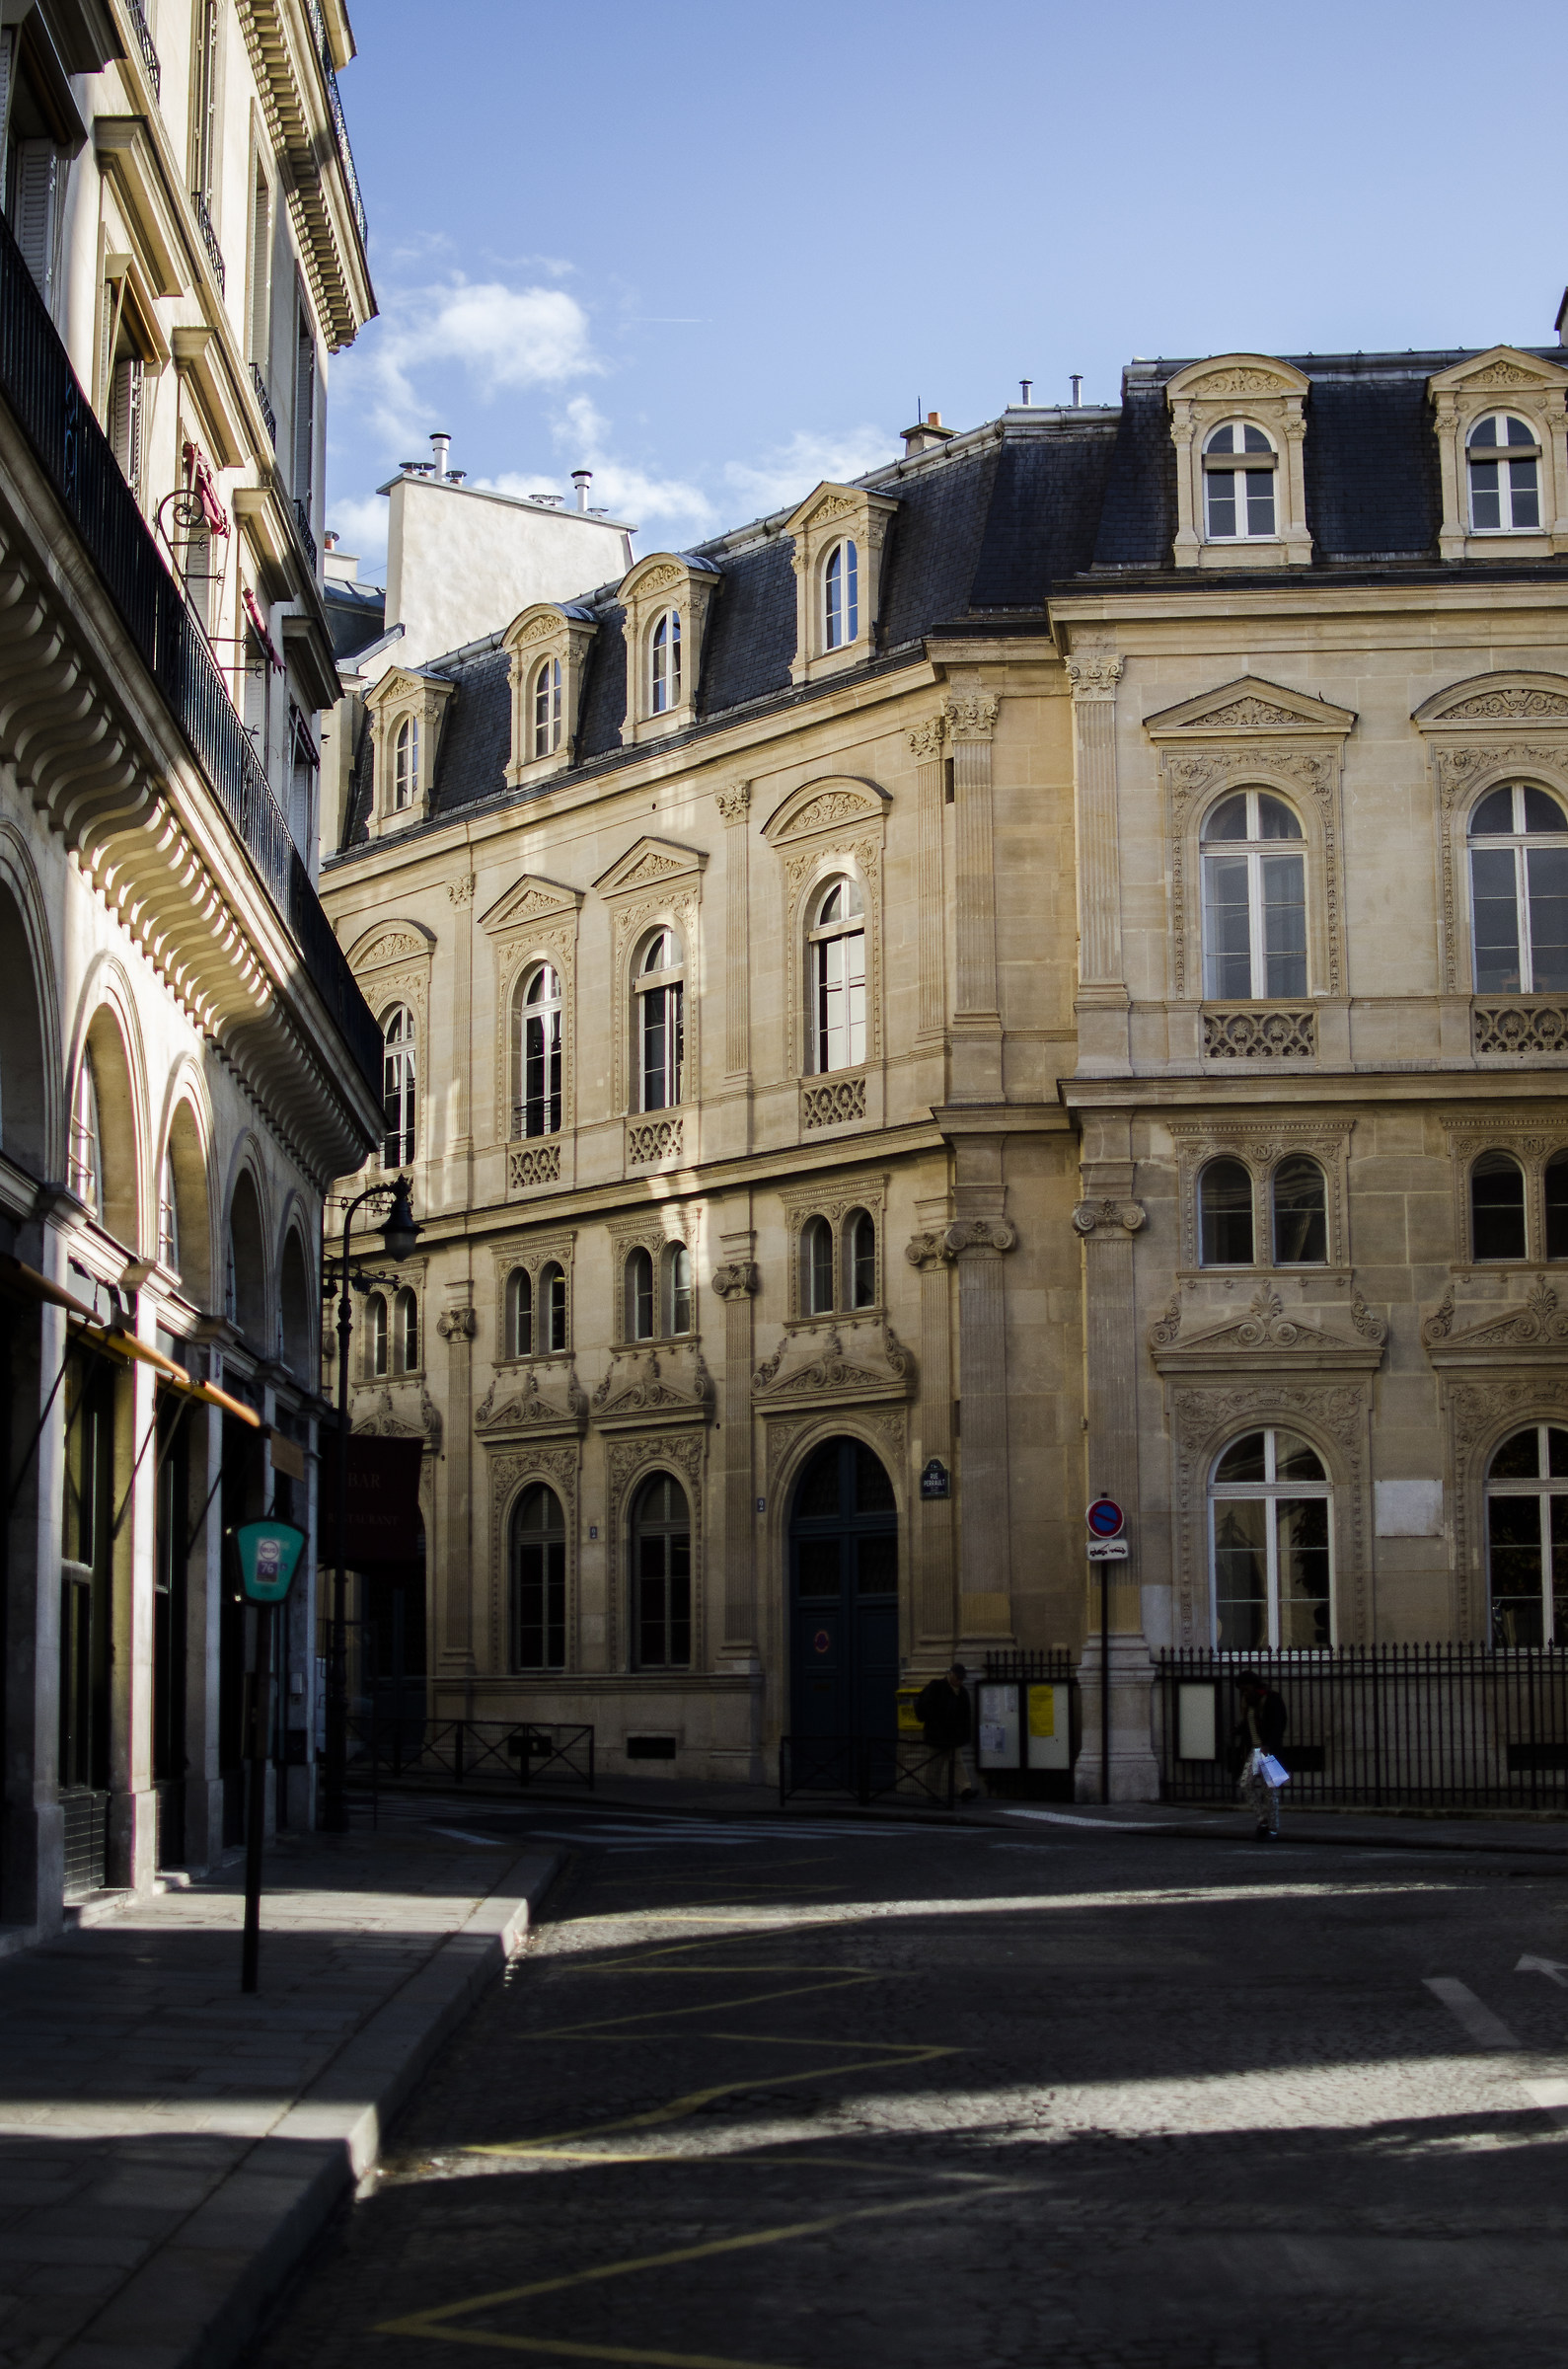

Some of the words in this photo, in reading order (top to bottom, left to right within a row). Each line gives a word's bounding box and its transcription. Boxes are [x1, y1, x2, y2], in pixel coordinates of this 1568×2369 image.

[347, 1472, 381, 1489] BAR
[328, 1513, 399, 1526] RTAURANT
[261, 1563, 274, 1573] 76
